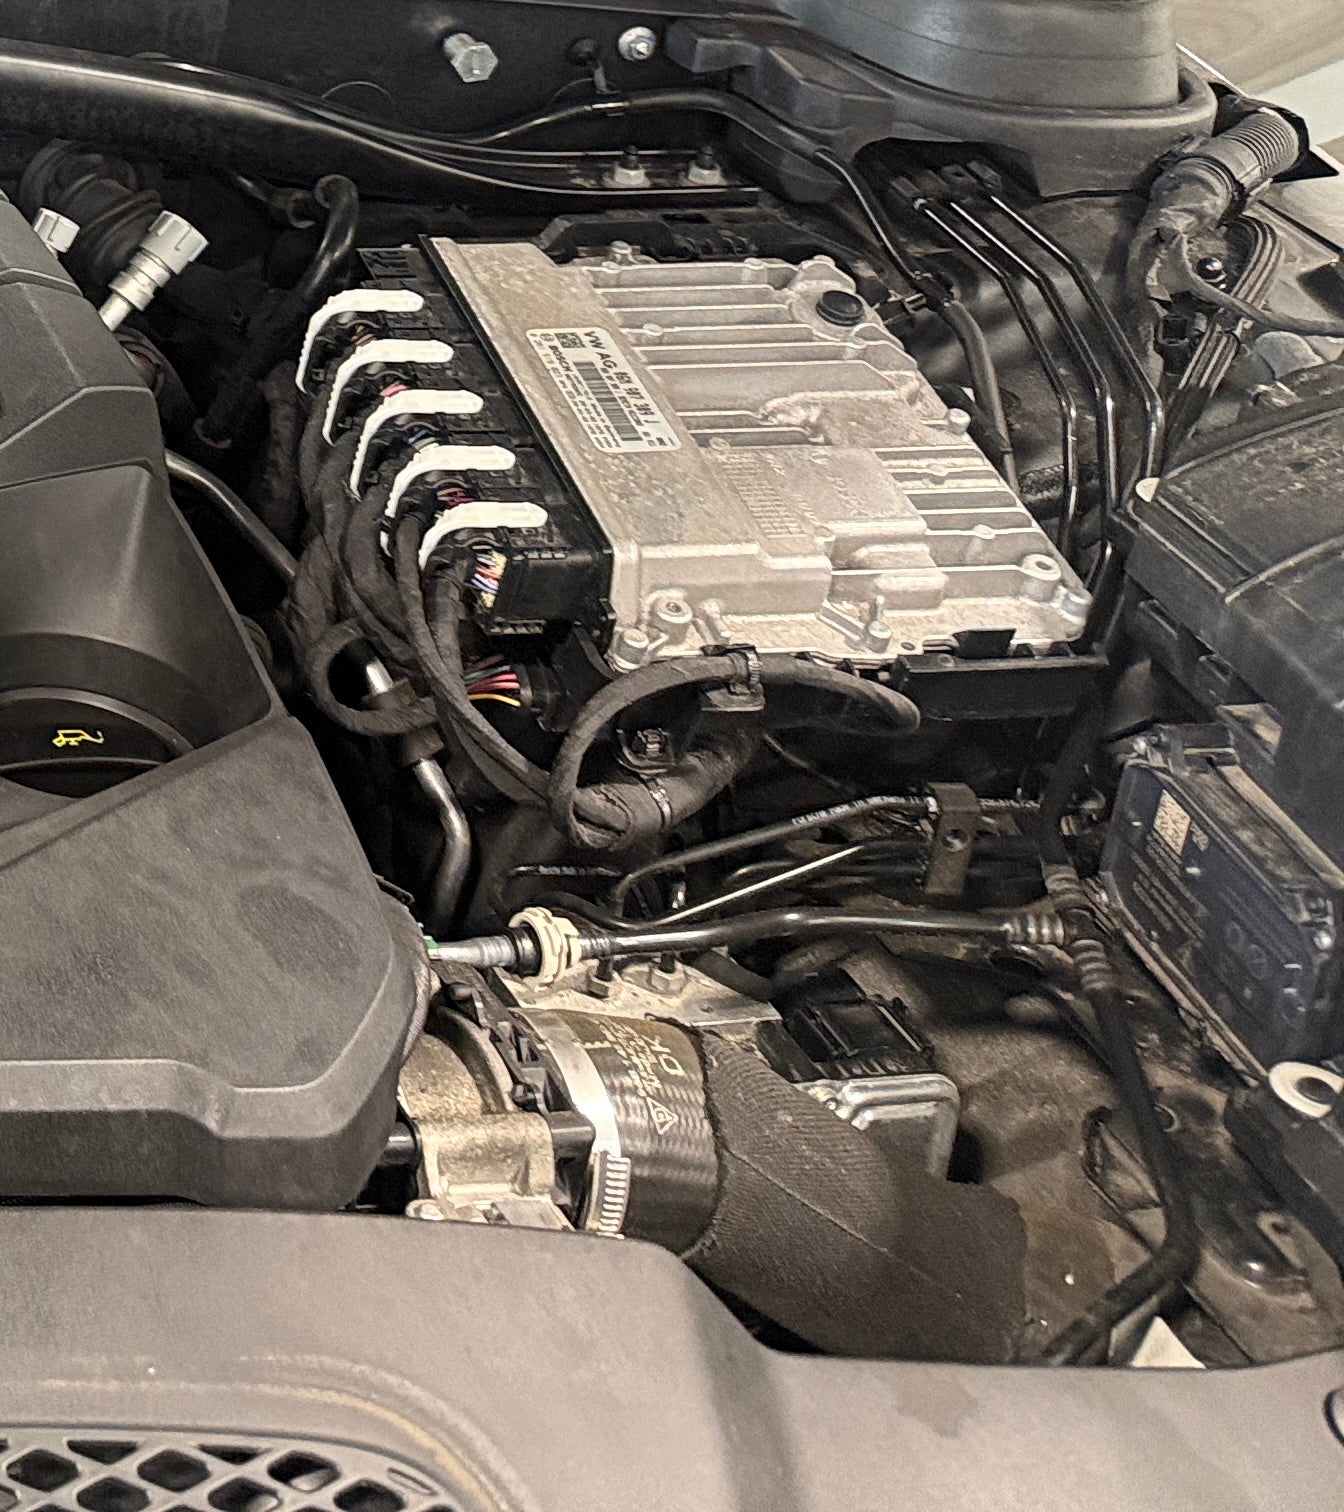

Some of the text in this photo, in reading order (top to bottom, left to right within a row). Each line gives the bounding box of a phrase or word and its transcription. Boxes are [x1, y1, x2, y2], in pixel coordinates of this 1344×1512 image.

[549, 345, 573, 372] BOSCH
[584, 331, 605, 350] VW
[597, 351, 618, 369] AG
[641, 1035, 686, 1076] OK
